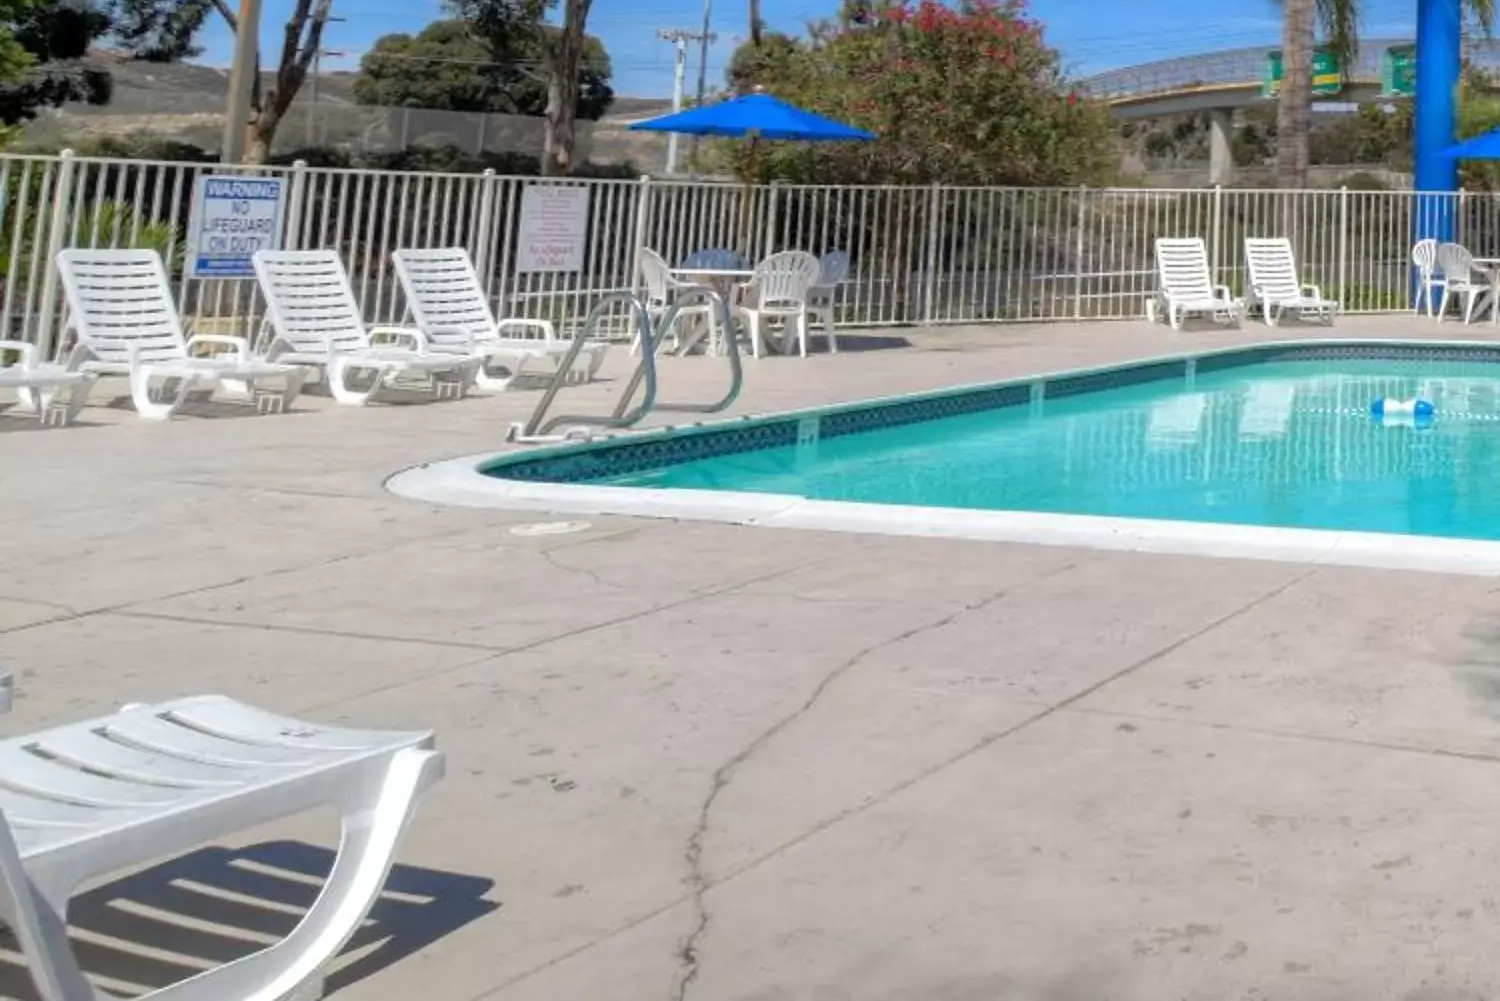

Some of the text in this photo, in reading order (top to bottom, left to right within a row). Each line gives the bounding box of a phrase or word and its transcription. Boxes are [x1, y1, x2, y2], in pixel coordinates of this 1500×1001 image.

[205, 182, 280, 199] WARNING
[232, 200, 251, 216] NO
[202, 217, 273, 235] LIFEGUARD
[209, 236, 227, 252] ON
